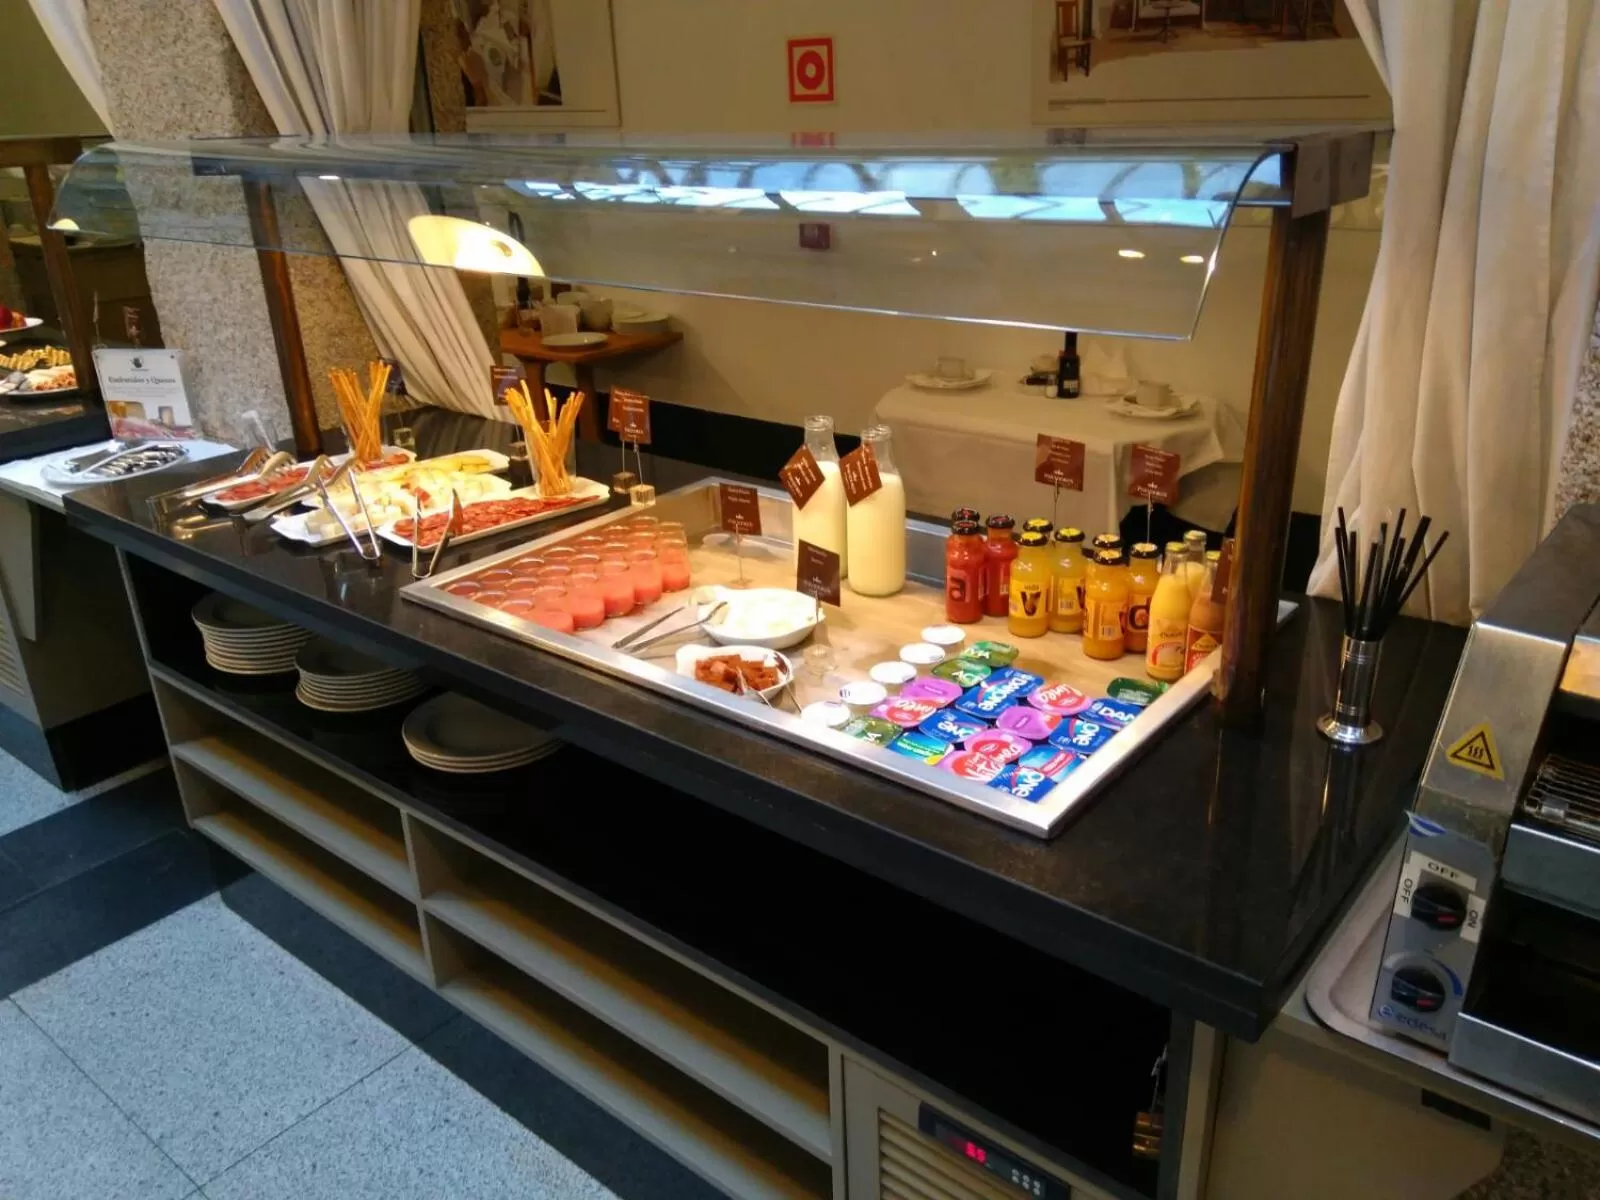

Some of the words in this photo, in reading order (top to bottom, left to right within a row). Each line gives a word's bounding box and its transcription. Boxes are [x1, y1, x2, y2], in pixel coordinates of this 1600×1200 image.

[1427, 861, 1461, 879] OFF
[1401, 878, 1413, 905] OFF
[1466, 909, 1479, 929] ON
